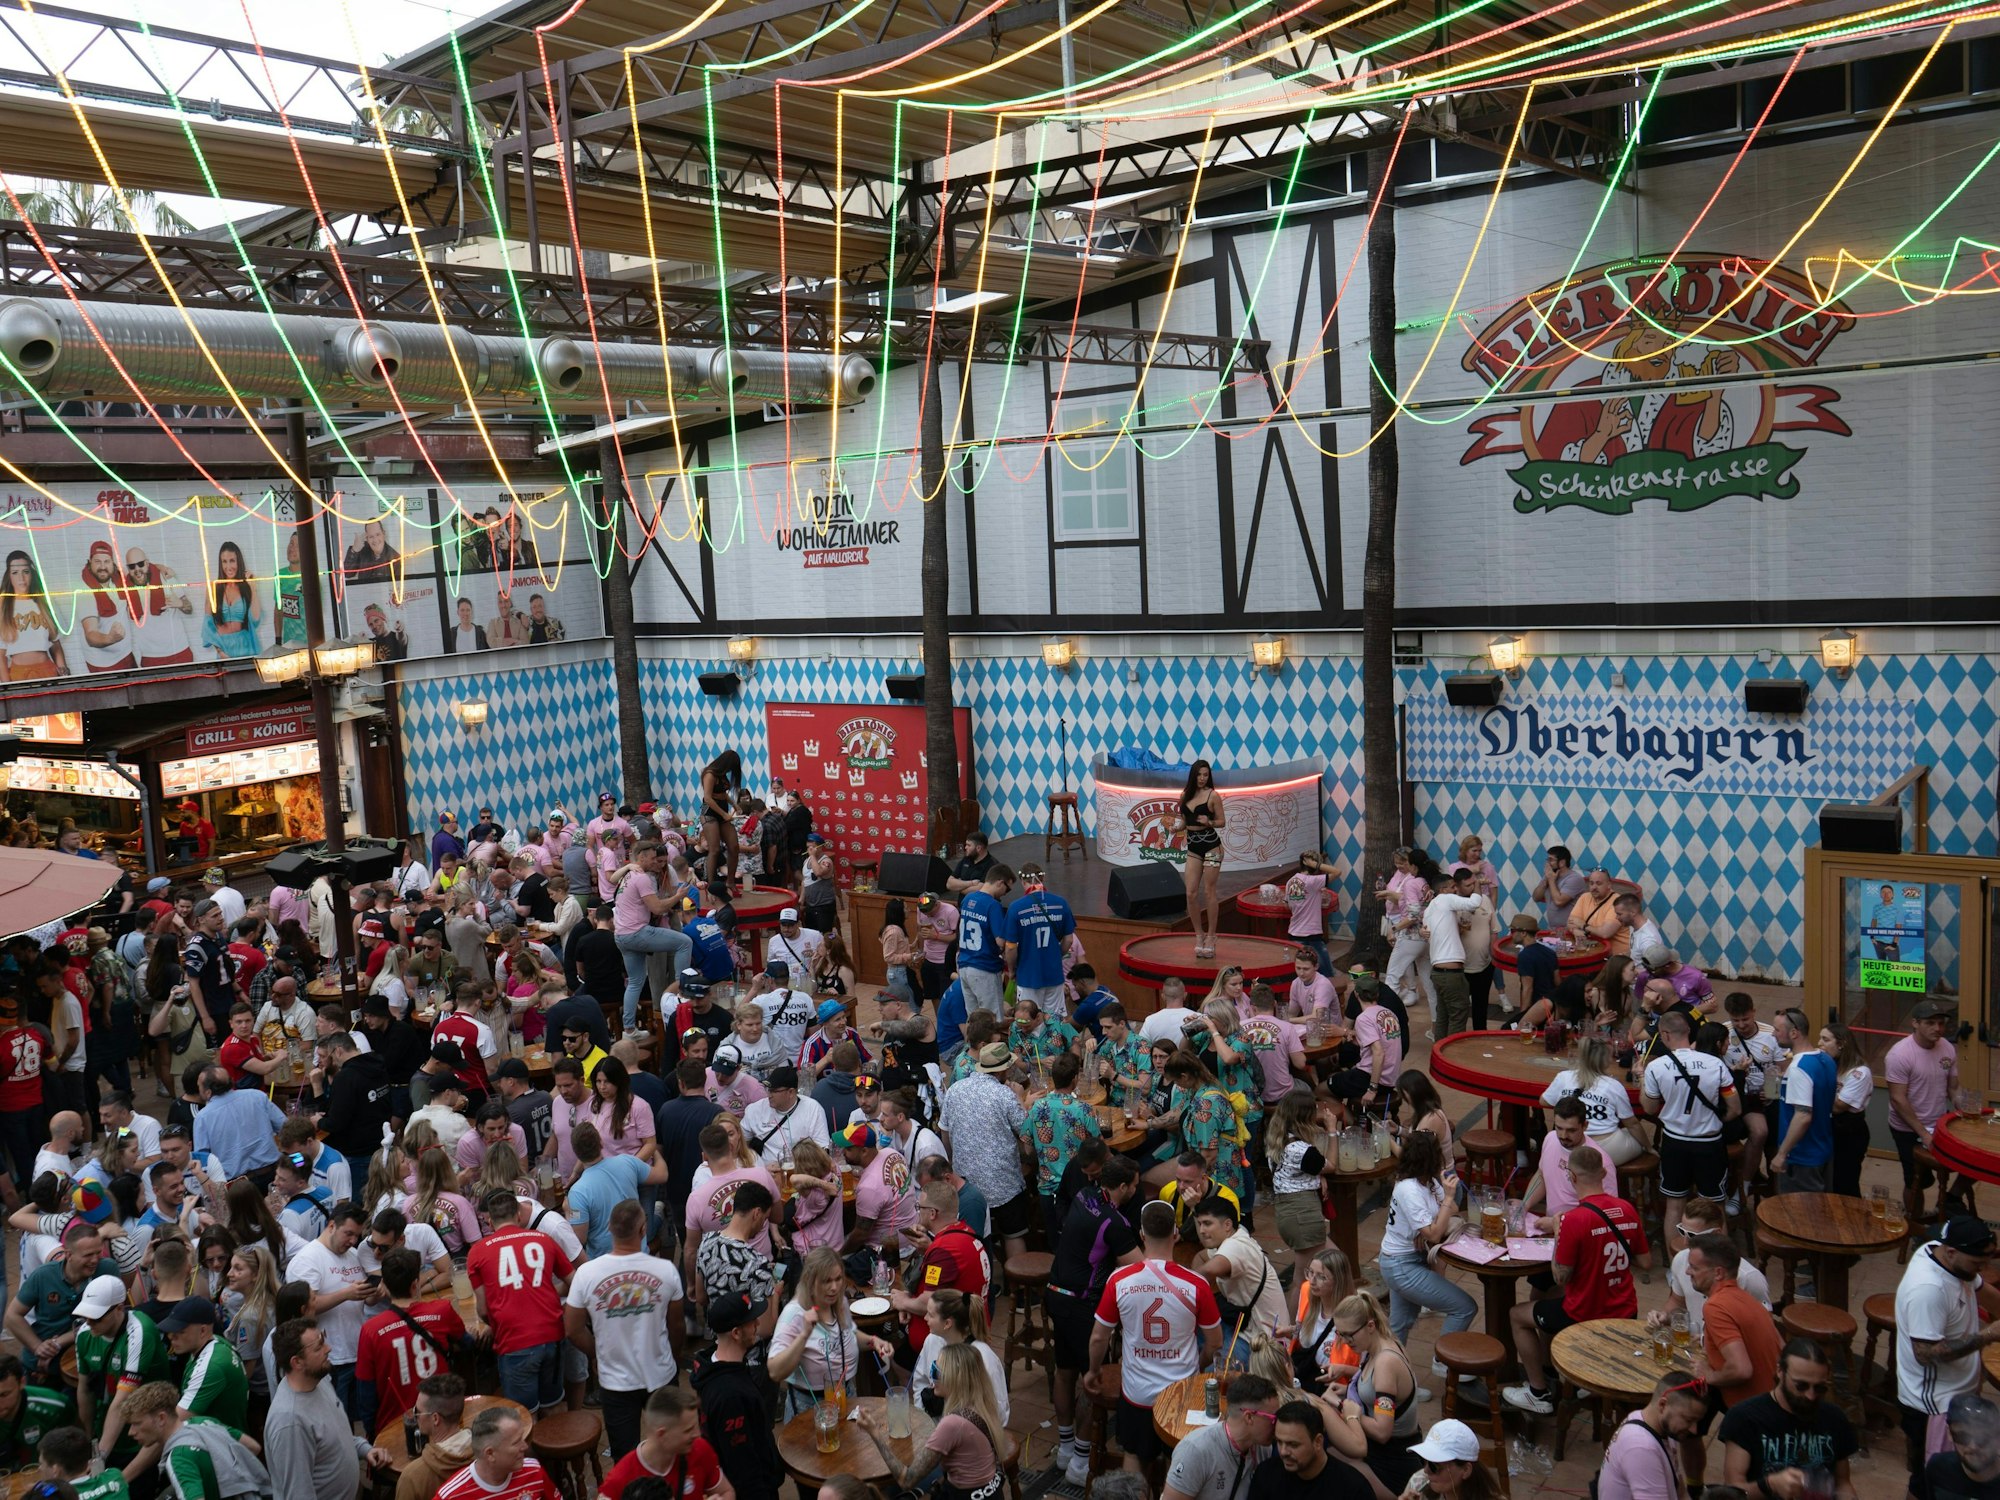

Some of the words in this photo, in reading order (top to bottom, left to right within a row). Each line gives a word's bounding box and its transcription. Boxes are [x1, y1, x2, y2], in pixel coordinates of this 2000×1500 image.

[1478, 265, 1830, 377] BIERKÖNIG
[1538, 454, 1771, 501] Schinkenstrasse
[812, 494, 854, 519] DEIN
[777, 520, 900, 551] WOHNZIMMER
[807, 553, 823, 566] AUF
[220, 713, 240, 723] einen
[240, 710, 271, 721] leckeren
[271, 706, 293, 717] Snack
[293, 704, 311, 714] beim
[194, 730, 236, 746] GRILL
[252, 721, 297, 738] KÖNIG
[838, 719, 896, 740] BIERKÖNIG
[1479, 704, 1817, 782] Oberbayern
[1130, 802, 1182, 825] BIERKÖ
[959, 918, 983, 951] 13
[1035, 926, 1051, 949] 17
[1863, 961, 1892, 971] HEUTE
[1893, 976, 1923, 989] LIVE!
[768, 1003, 808, 1012] BIEKÖNIG
[776, 1011, 808, 1026] 988
[12, 1039, 41, 1077] 18
[1664, 1061, 1687, 1071] VII
[1561, 1088, 1609, 1105] BIEKÖNIG
[1674, 1075, 1700, 1115] 7
[531, 1104, 549, 1120] GÖTZE
[1586, 1104, 1608, 1121] 88
[710, 1181, 744, 1206] BIERK
[498, 1242, 545, 1290] 49
[1603, 1239, 1631, 1275] 25
[595, 1272, 662, 1297] BIERKÖNIG
[1121, 1287, 1129, 1295] FC
[1129, 1285, 1156, 1294] BAYERN
[1159, 1285, 1190, 1296] MÜNEN
[1142, 1297, 1170, 1344] 6
[391, 1331, 438, 1386] 18
[1134, 1346, 1181, 1359] KIMMICH
[78, 1483, 107, 1500] reven
[971, 1473, 1002, 1500] adid
